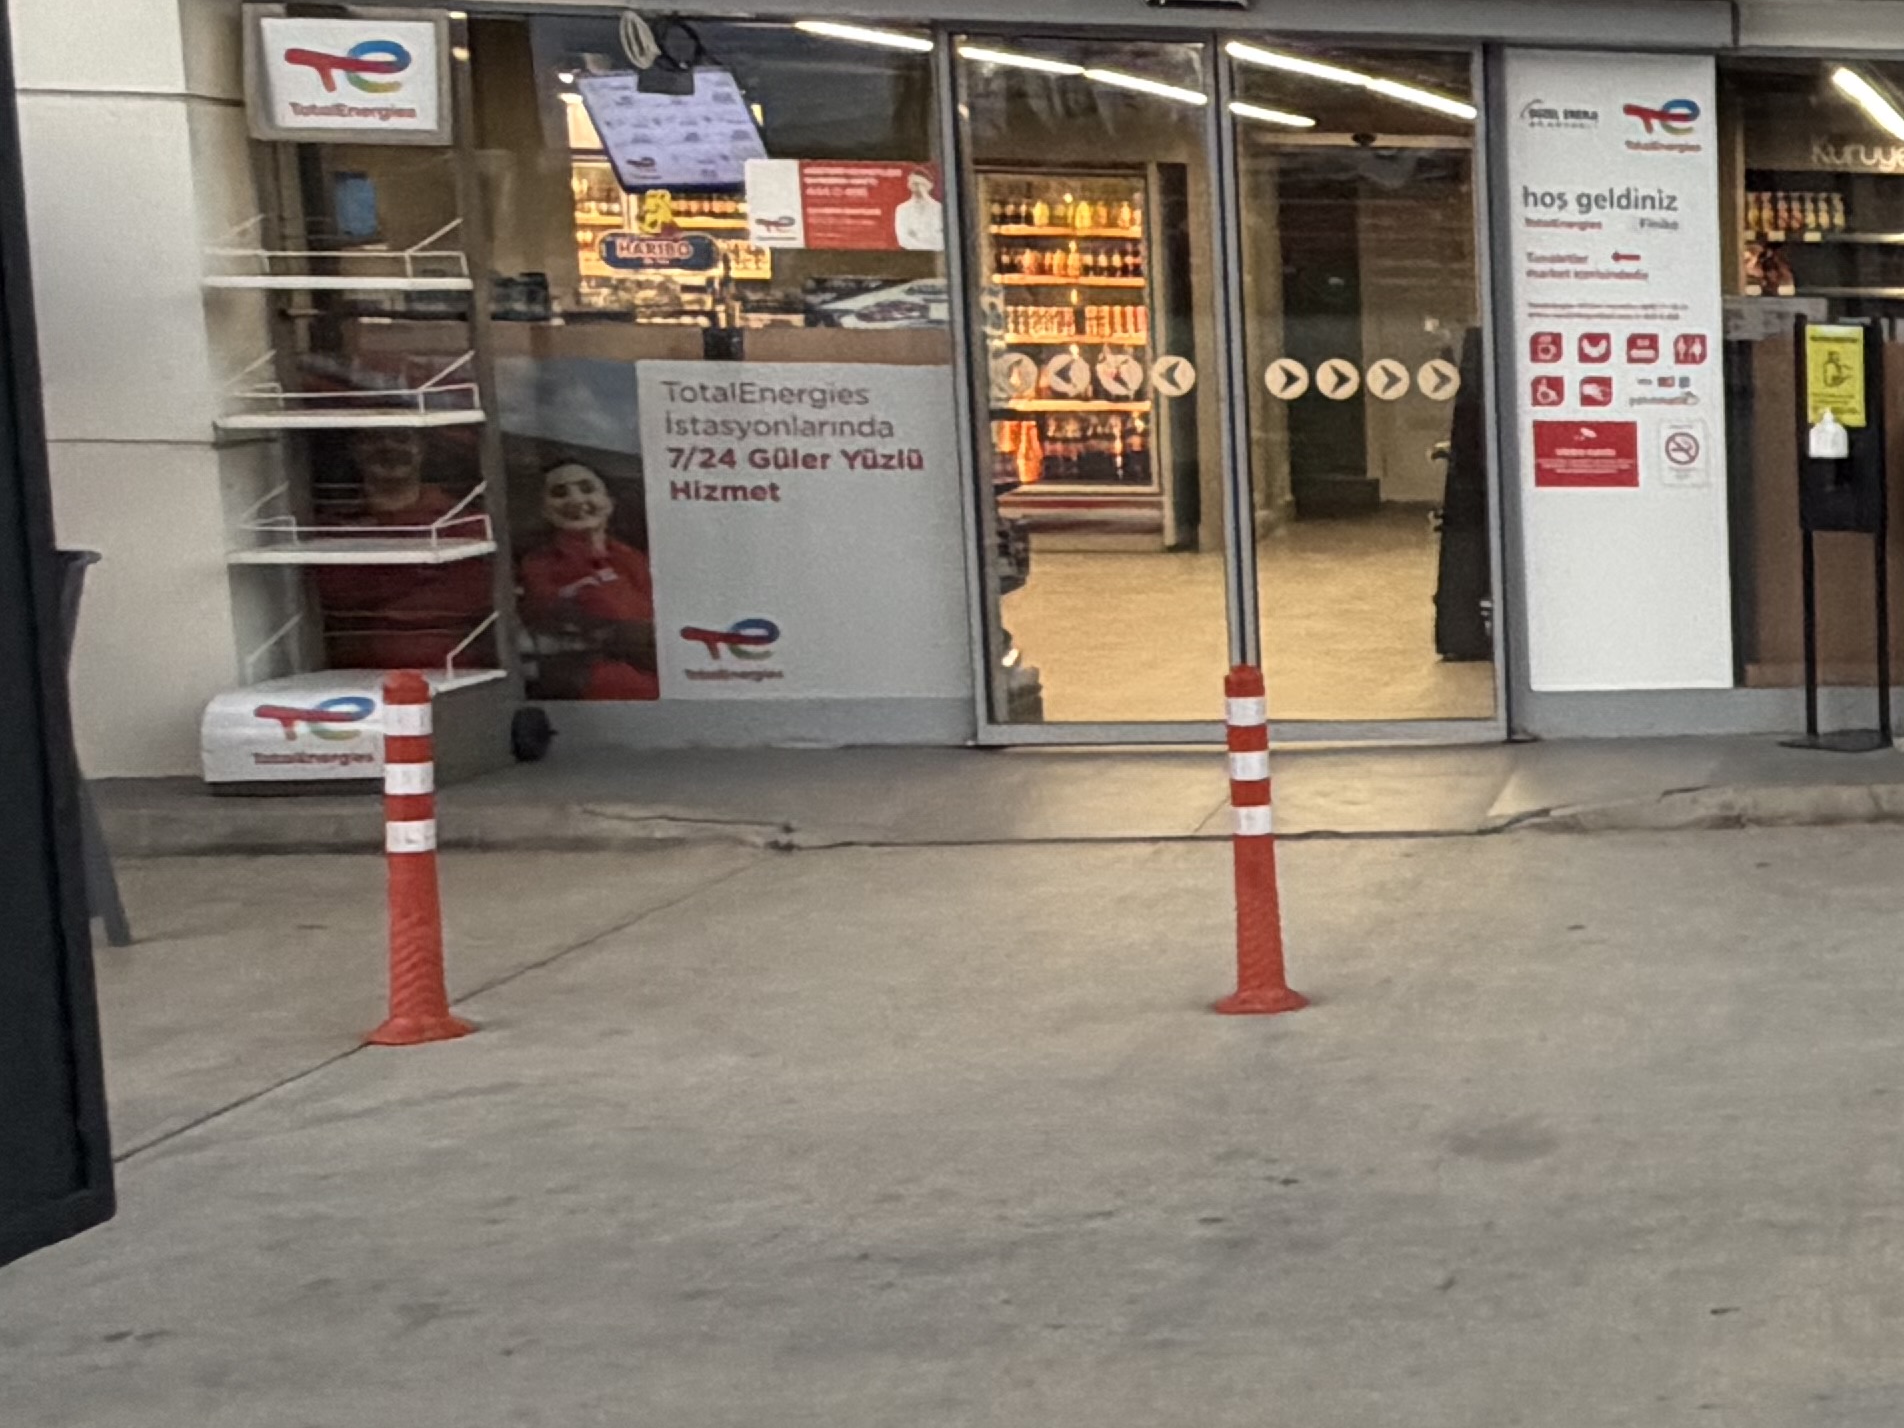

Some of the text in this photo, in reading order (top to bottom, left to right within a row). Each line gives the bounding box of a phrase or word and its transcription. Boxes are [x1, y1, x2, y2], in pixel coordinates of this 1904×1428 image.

[288, 102, 418, 121] TotalEnergies
[1522, 185, 1679, 214] hoş geldiniz
[617, 239, 691, 257] HARIBO
[660, 381, 870, 409] TotalEnergies
[665, 411, 895, 440] İstasyonlarında
[666, 447, 925, 471] 7/24 Güler Yüzlü
[669, 480, 782, 503] Hizmet
